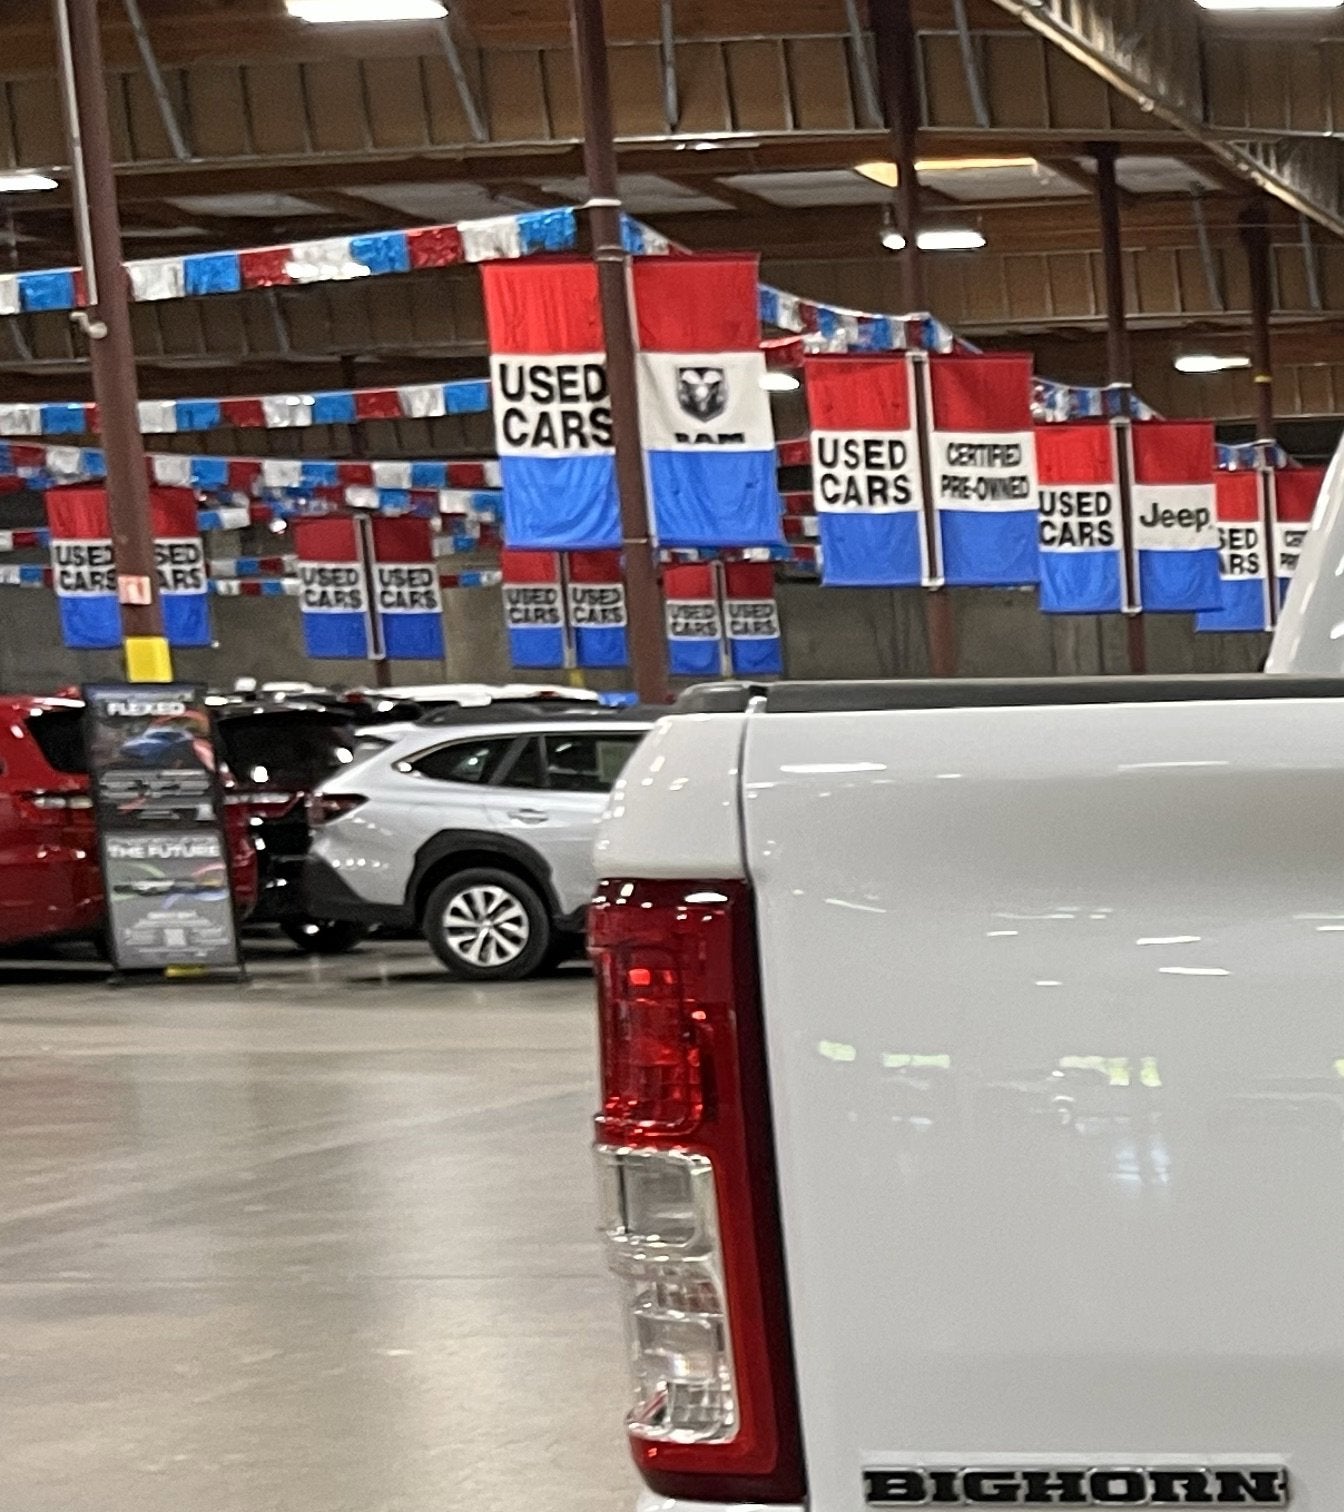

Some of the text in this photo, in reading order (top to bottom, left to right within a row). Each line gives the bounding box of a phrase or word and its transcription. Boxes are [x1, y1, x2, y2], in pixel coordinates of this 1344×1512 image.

[500, 363, 608, 404] USED
[502, 408, 614, 449] CARS
[818, 436, 907, 471] USED
[947, 442, 1022, 467] CERTIFIED
[820, 473, 912, 506] CARS
[941, 475, 1029, 501] PRE-OWNED
[1039, 490, 1112, 517] USED
[1139, 502, 1209, 533] Jeep
[1040, 519, 1115, 548] CARS
[1217, 528, 1258, 550] SED
[154, 543, 200, 565] SED
[60, 568, 117, 591] CARS
[159, 568, 201, 590] ARS
[301, 567, 360, 589] USED
[378, 566, 436, 589] USED
[303, 589, 363, 610] CARS
[379, 588, 439, 610] CARS
[507, 587, 558, 604] USED
[572, 587, 621, 604] USED
[510, 607, 561, 624] CARS
[573, 606, 624, 623] CARS
[862, 1466, 1290, 1507] BIGHORN
